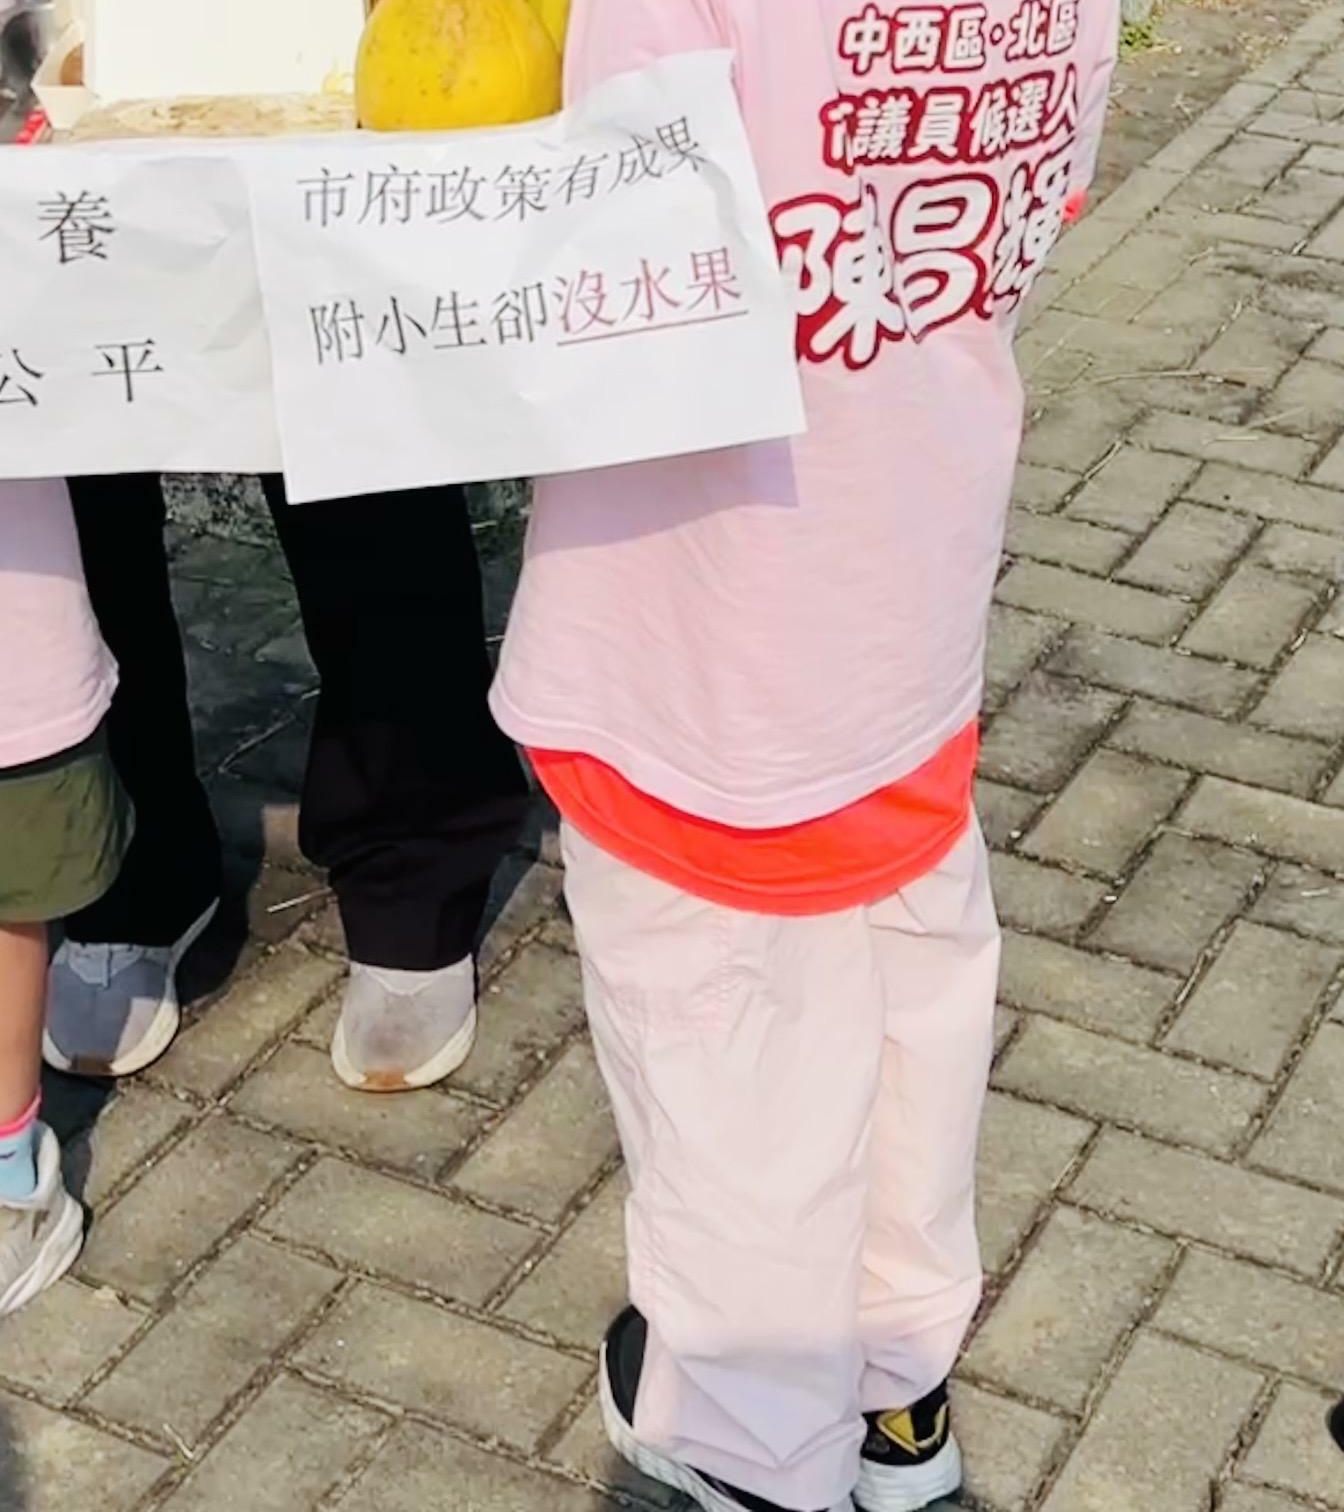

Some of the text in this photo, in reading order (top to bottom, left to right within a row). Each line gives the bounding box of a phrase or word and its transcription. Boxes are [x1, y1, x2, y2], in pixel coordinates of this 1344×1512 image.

[296, 115, 710, 228] 市府政策有成果
